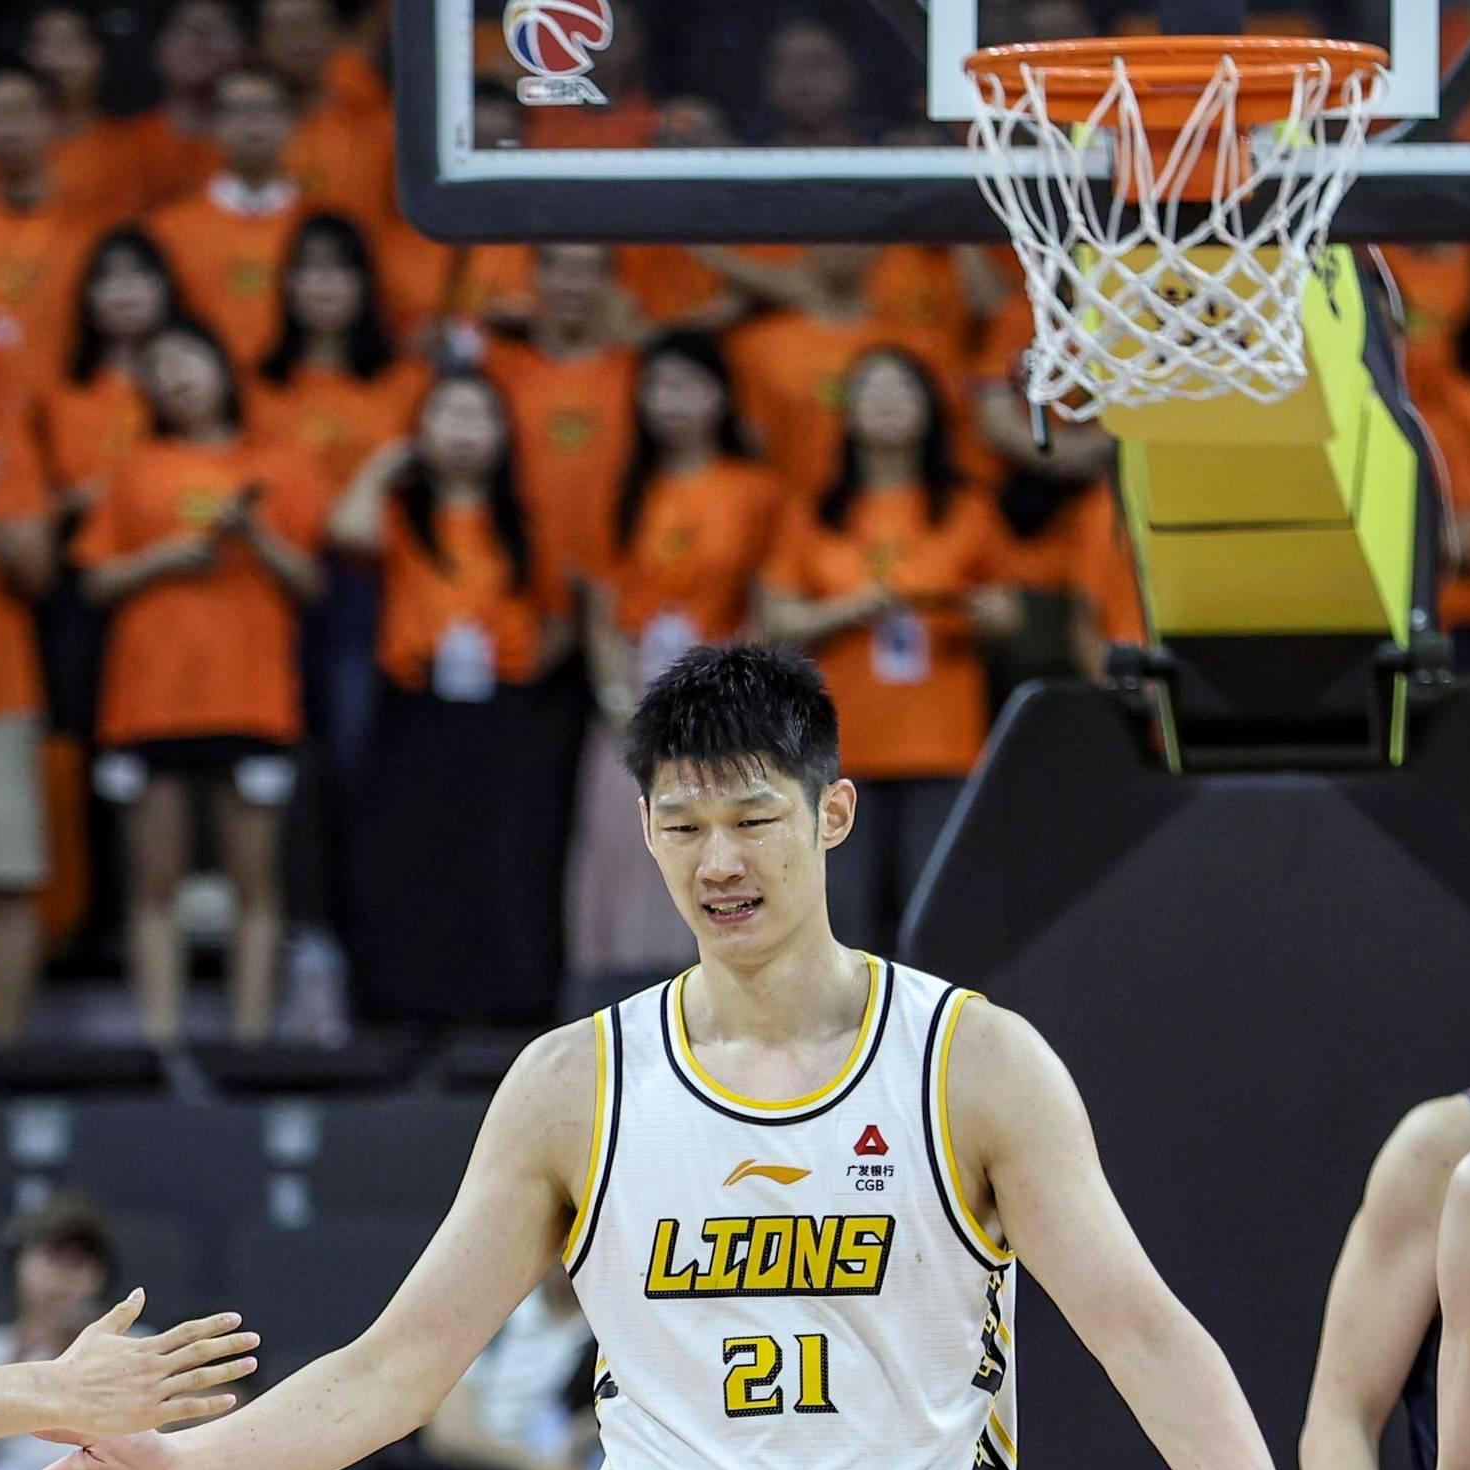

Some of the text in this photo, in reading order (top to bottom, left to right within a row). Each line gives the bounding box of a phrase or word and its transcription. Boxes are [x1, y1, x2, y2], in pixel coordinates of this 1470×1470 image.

[846, 1165, 894, 1177] 广发银行
[855, 1179, 884, 1191] CGB
[644, 1214, 896, 1300] LIONS
[723, 1334, 839, 1418] 21
